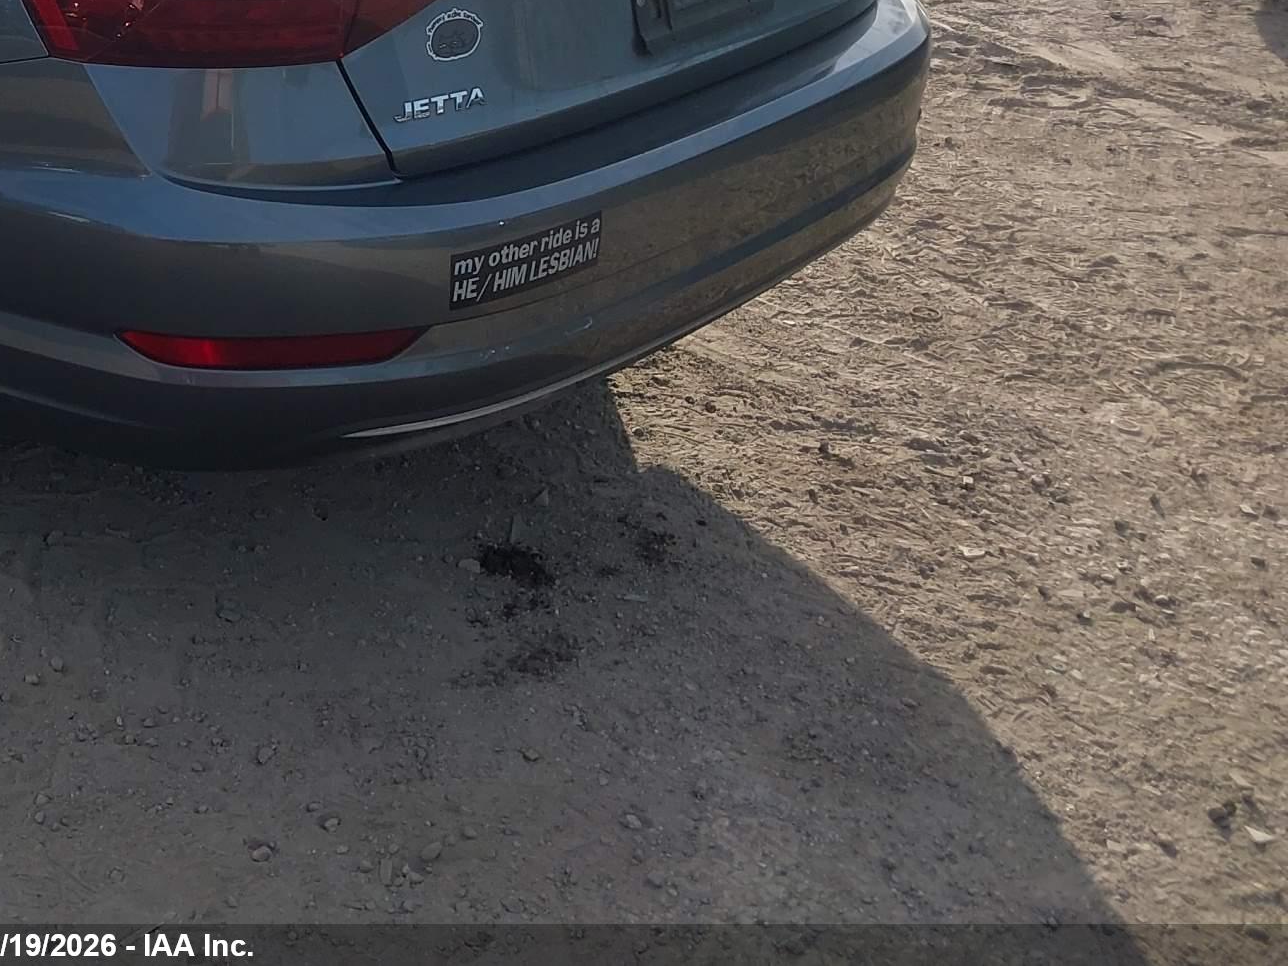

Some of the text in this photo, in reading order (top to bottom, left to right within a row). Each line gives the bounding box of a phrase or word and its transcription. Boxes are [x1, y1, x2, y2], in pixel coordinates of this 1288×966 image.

[393, 87, 486, 122] JETTA
[454, 217, 601, 275] my other ride is a
[529, 237, 600, 282] LESBIAN!
